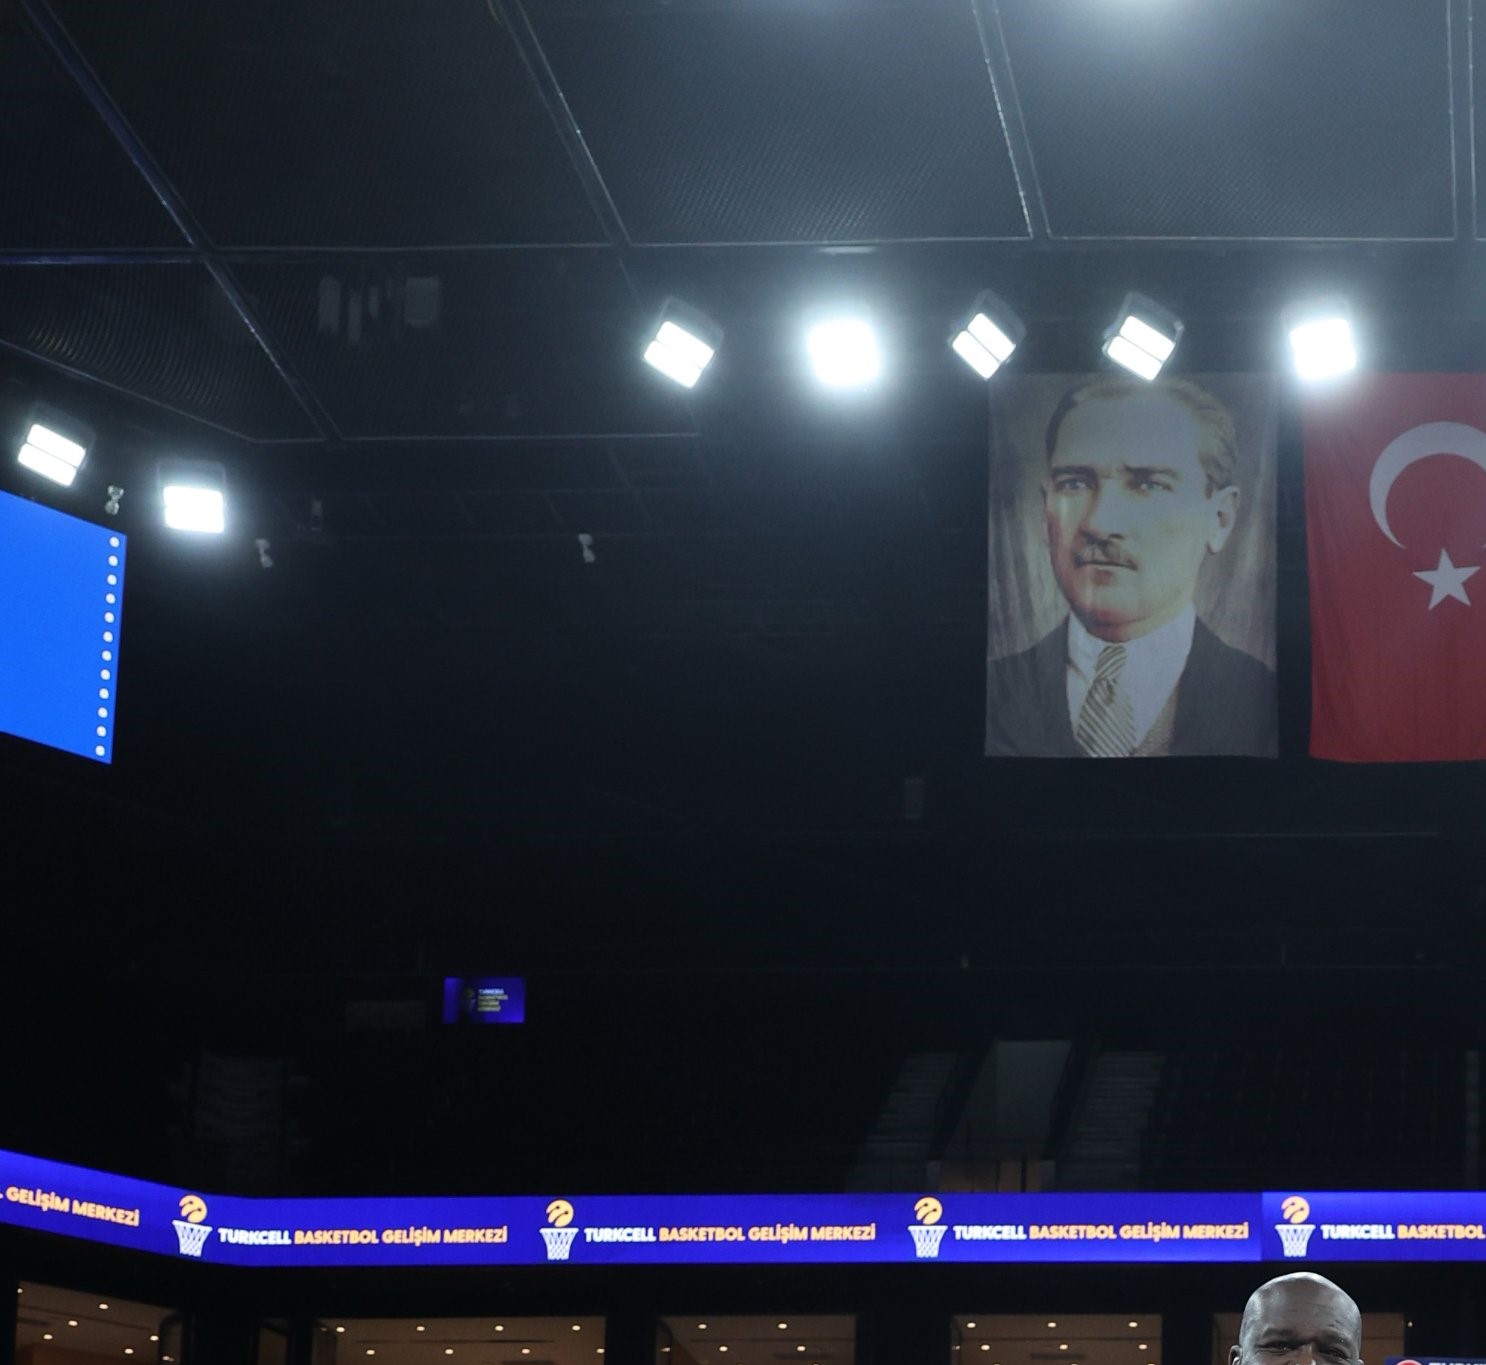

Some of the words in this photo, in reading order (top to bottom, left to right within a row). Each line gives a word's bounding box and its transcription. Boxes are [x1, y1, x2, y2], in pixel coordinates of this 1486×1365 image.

[6, 1186, 70, 1212] GELİŞİM
[72, 1199, 140, 1227] MERKEZİ
[218, 1228, 292, 1245] TURKCELL
[294, 1230, 379, 1244] BASKETBOL
[382, 1226, 441, 1247] GELİŞİM
[443, 1226, 507, 1243] MERKEZİ
[584, 1227, 657, 1242] TURKCELL
[659, 1227, 746, 1241] BASKETBOL
[748, 1223, 808, 1244] GELİŞİM
[810, 1223, 876, 1241] MERKEZİ
[953, 1225, 1027, 1240] TURKCELL
[1029, 1225, 1117, 1240] BASKETBOL
[1119, 1222, 1180, 1242] GELİŞİM
[1183, 1222, 1249, 1239] MERKEZİ
[1320, 1224, 1395, 1239] TURKCELL
[1397, 1224, 1486, 1239] BASKETBOL
